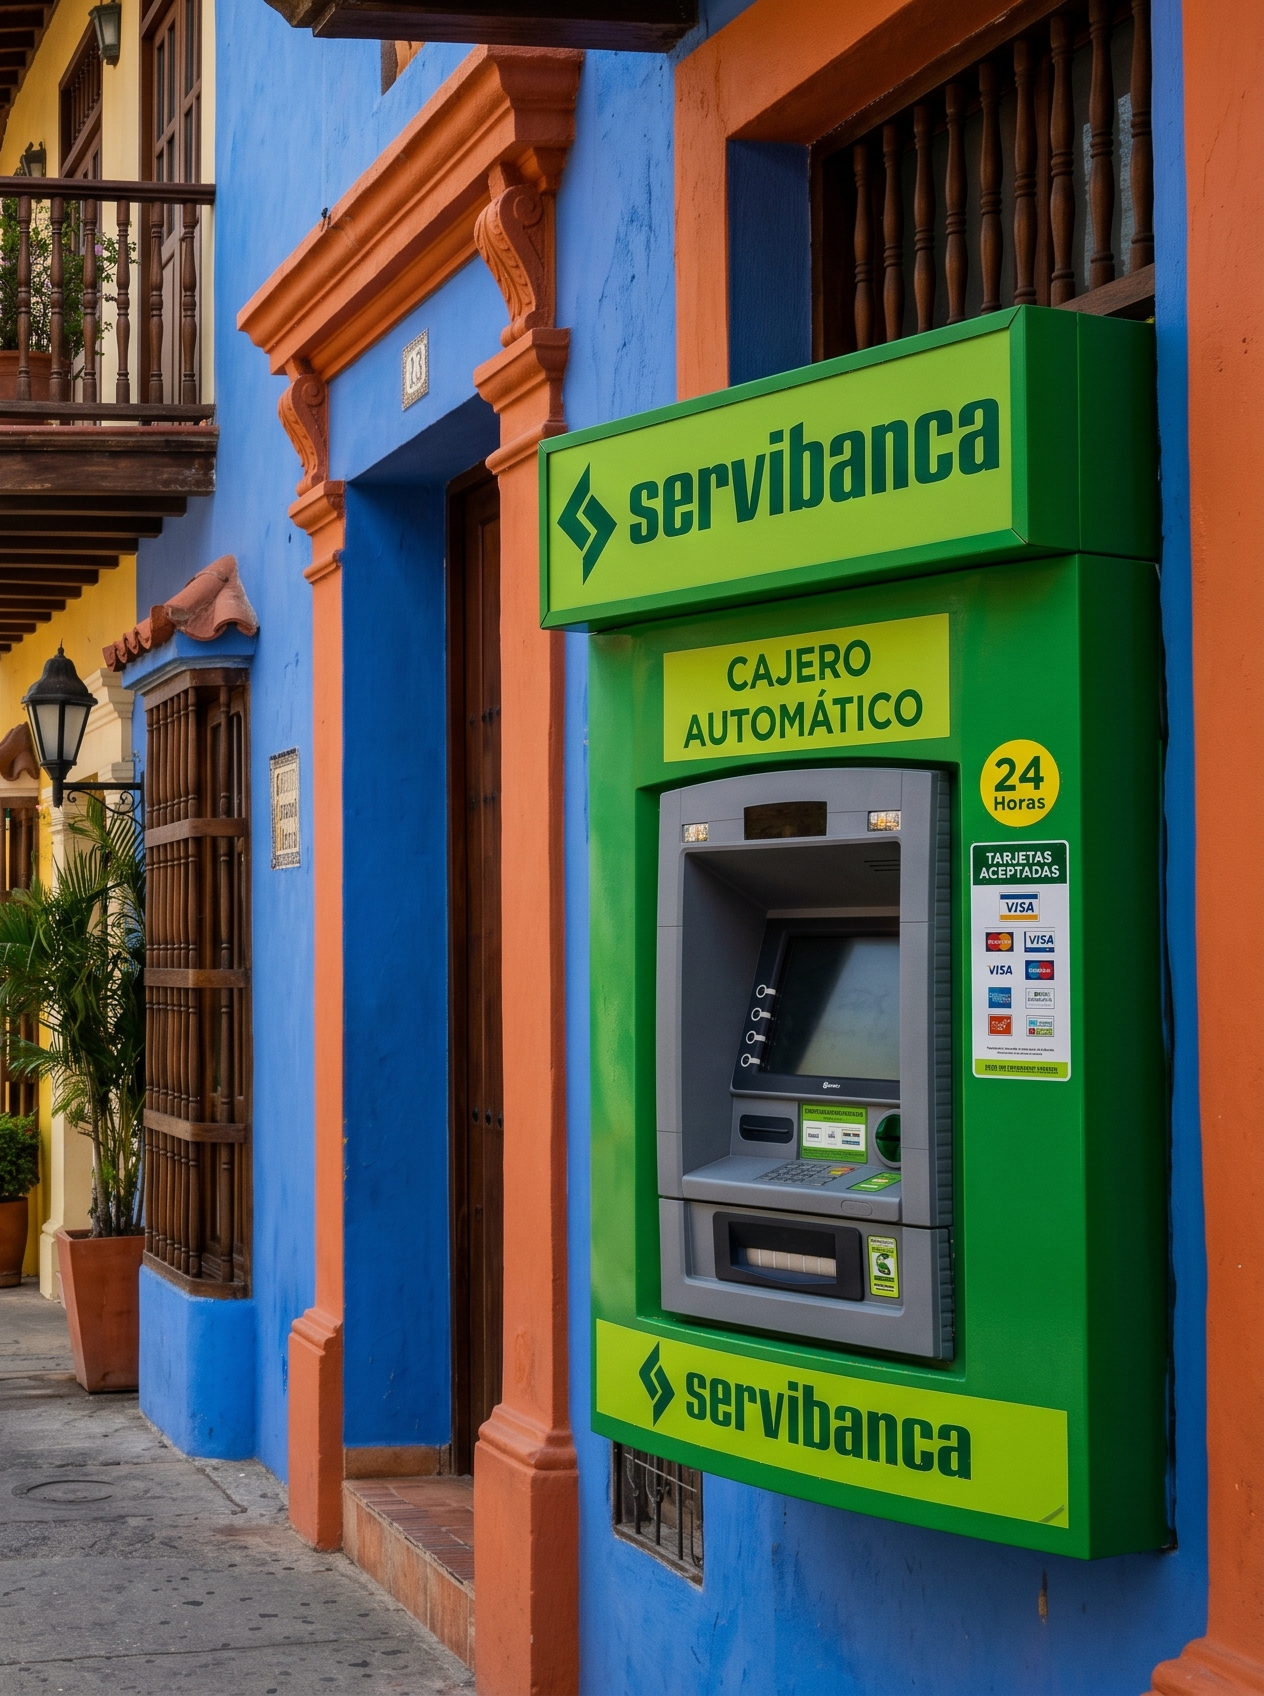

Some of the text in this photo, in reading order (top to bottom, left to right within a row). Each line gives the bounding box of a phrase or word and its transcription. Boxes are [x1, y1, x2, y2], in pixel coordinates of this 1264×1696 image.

[628, 397, 1001, 545] servibanca
[726, 639, 872, 692] CAJERO
[683, 688, 923, 749] AUTOMÁTICO
[994, 755, 1045, 793] 24
[994, 795, 1046, 812] Horas
[986, 851, 1052, 865] TARJETAS
[979, 865, 1060, 879] ACEPTADAS
[1005, 901, 1035, 913] VISA
[1028, 934, 1054, 945] VISA
[987, 964, 1013, 975] VISA
[685, 1370, 972, 1481] servibanca
